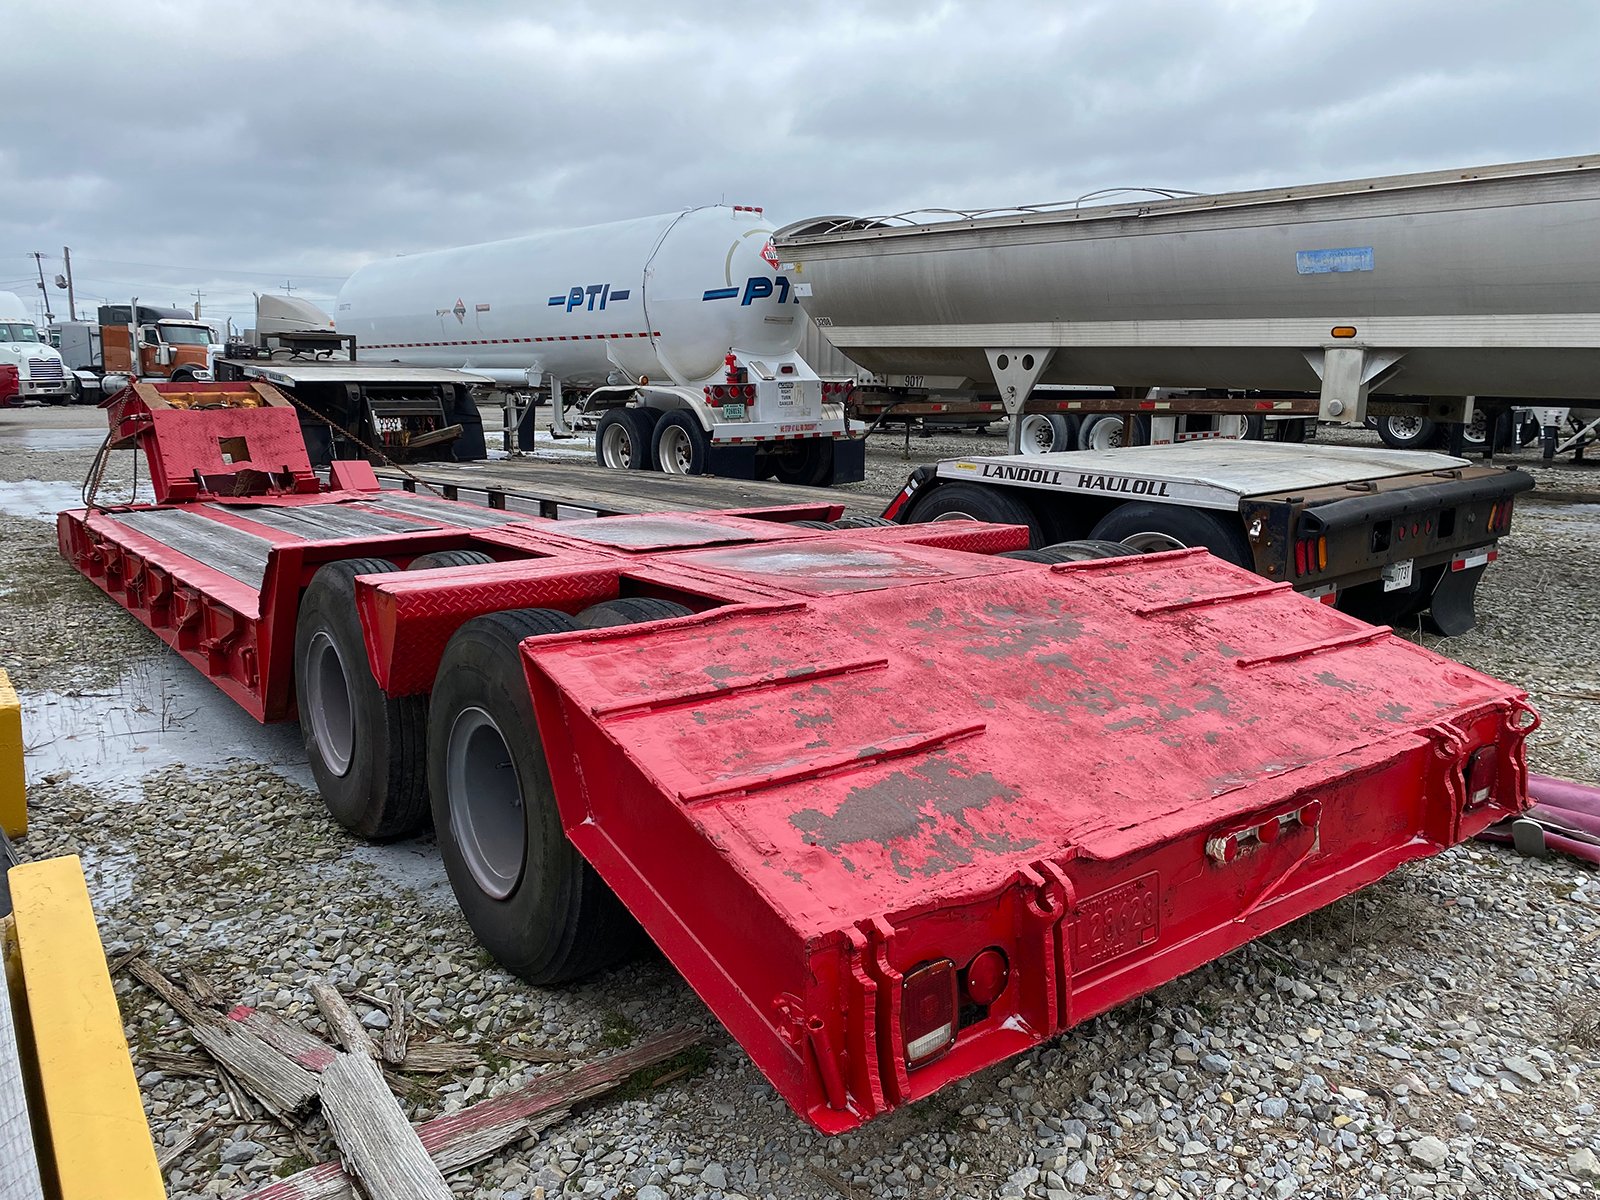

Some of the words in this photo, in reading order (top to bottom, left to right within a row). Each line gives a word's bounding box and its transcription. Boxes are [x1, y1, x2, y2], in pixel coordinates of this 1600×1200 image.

[741, 276, 799, 306] PT
[904, 375, 924, 387] 9017
[982, 464, 1062, 486] LANDOLL
[1077, 474, 1170, 498] HAULOLL
